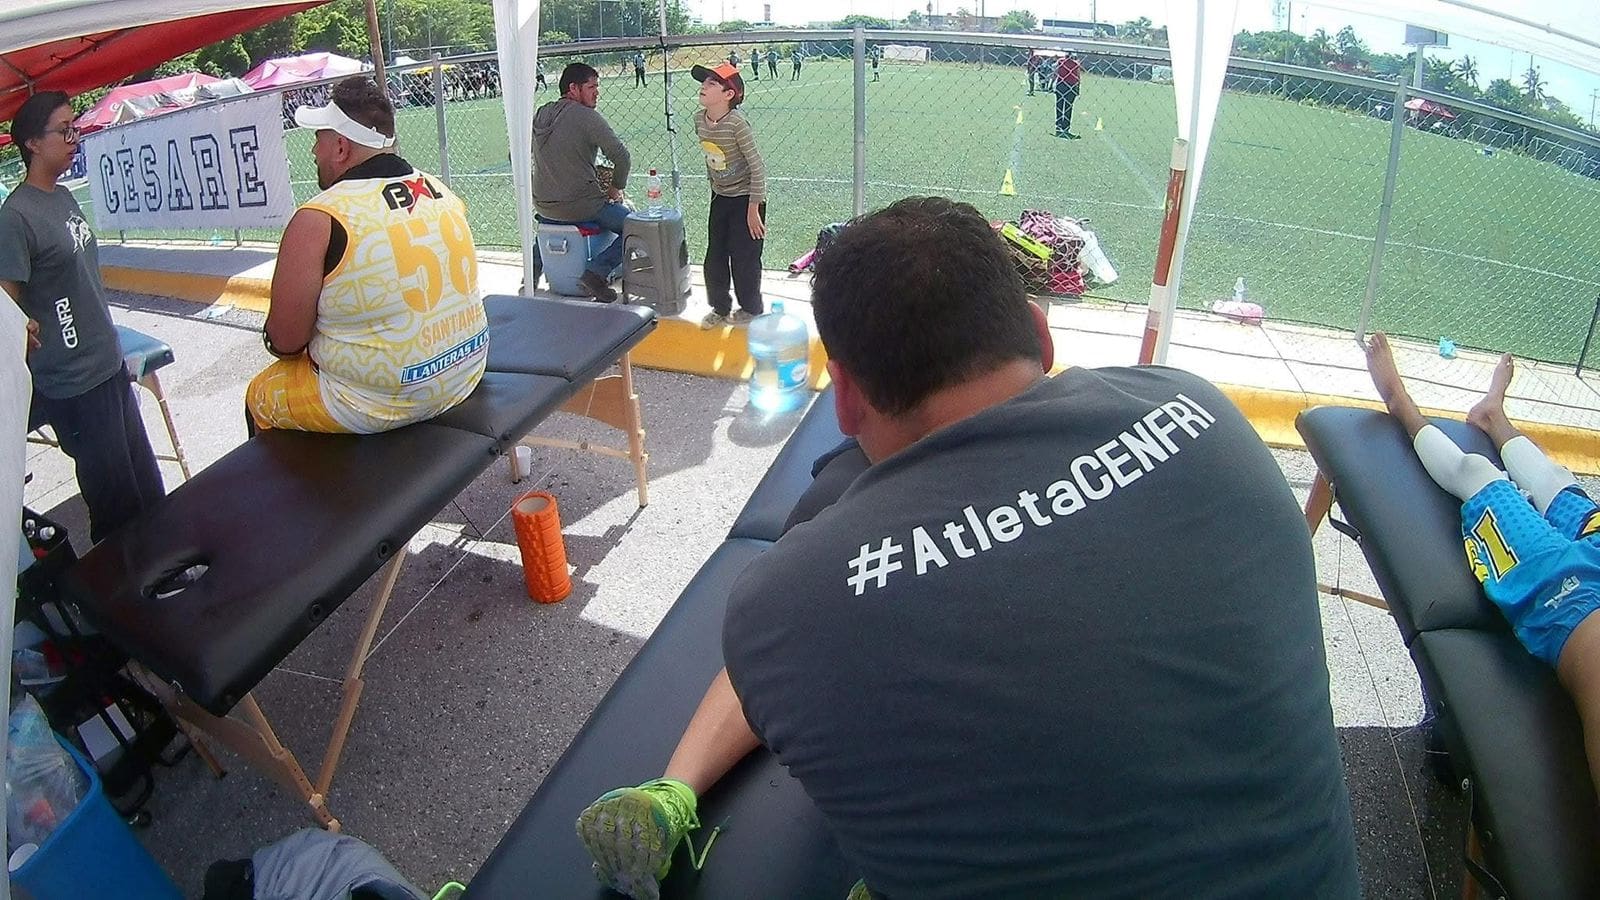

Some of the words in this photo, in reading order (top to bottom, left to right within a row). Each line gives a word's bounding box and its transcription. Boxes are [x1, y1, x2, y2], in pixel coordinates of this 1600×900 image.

[100, 125, 268, 214] CÉSARE
[381, 175, 444, 216] BXL
[386, 209, 479, 313] 58
[847, 393, 1217, 596] #AtletaCENFRI
